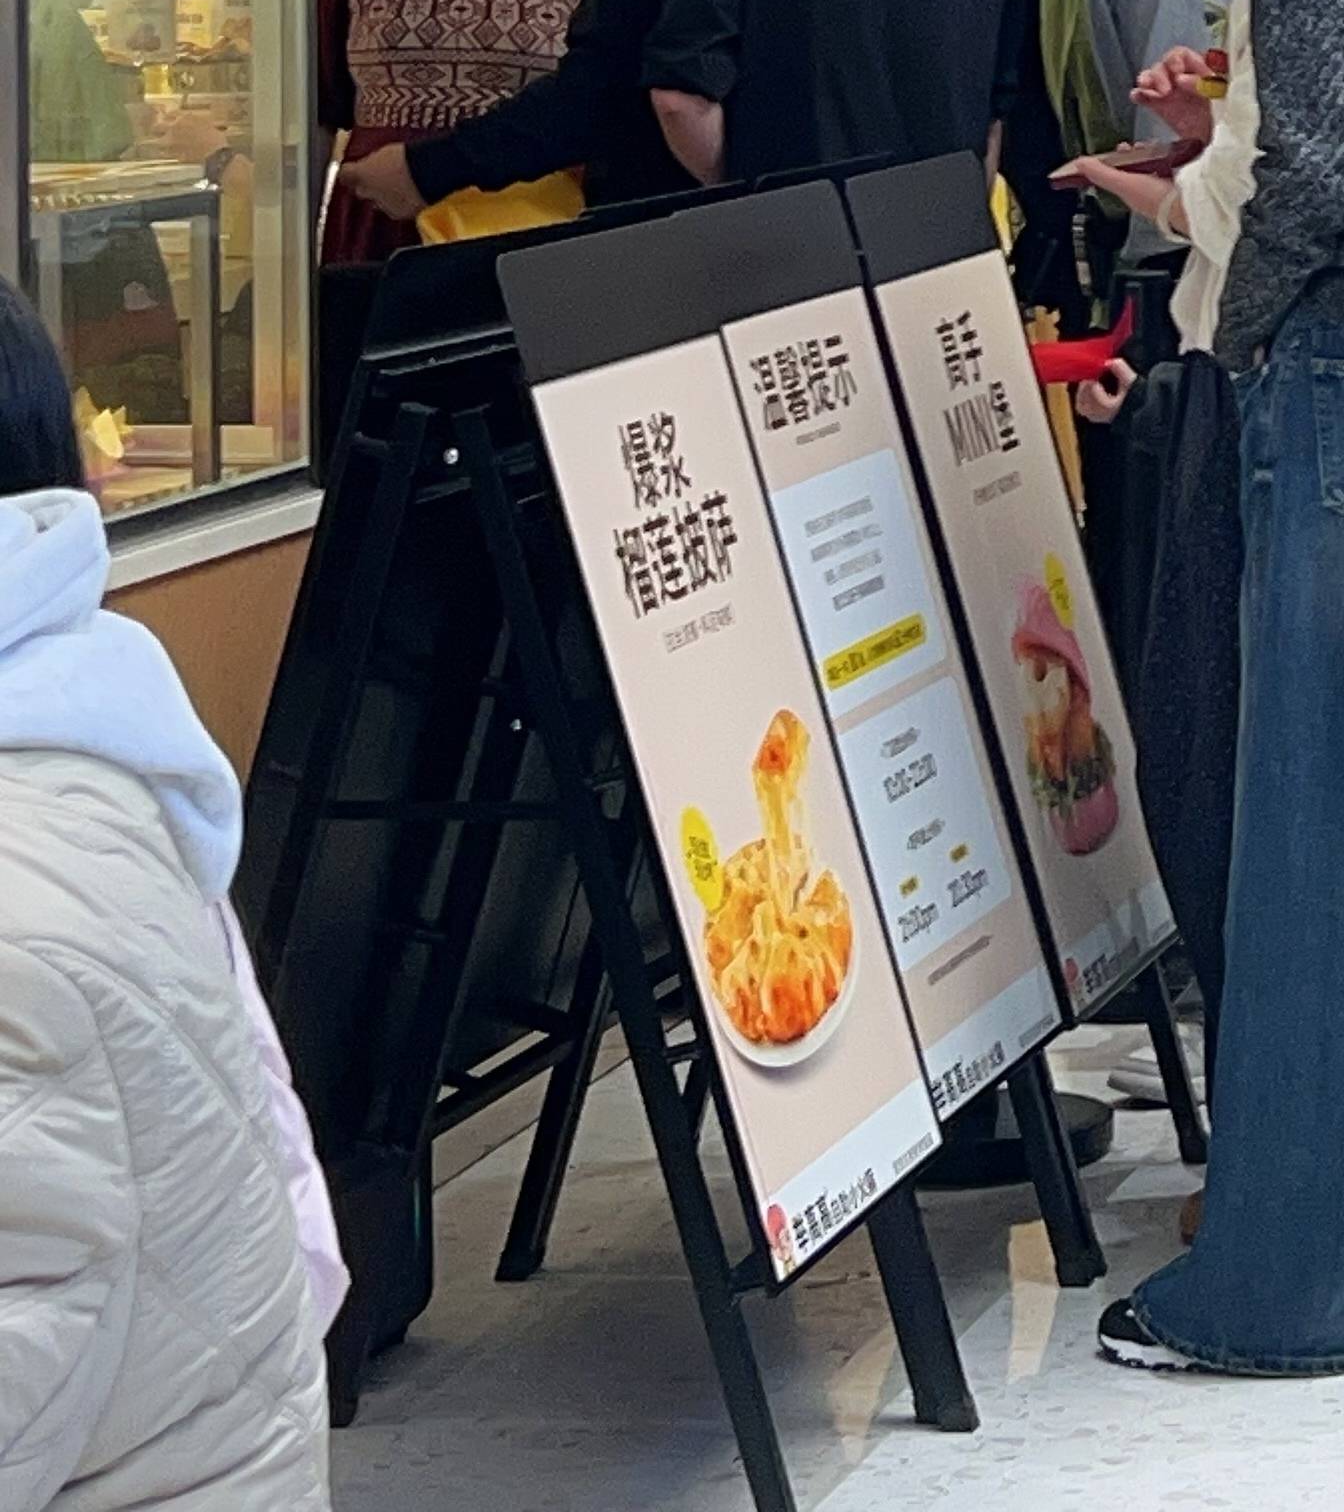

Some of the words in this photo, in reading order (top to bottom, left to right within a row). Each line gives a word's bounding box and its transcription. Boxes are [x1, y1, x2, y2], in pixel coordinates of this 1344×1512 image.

[750, 335, 858, 430] 温馨提示
[617, 411, 692, 511] 爆浆
[612, 490, 738, 620] 榴莲披萨
